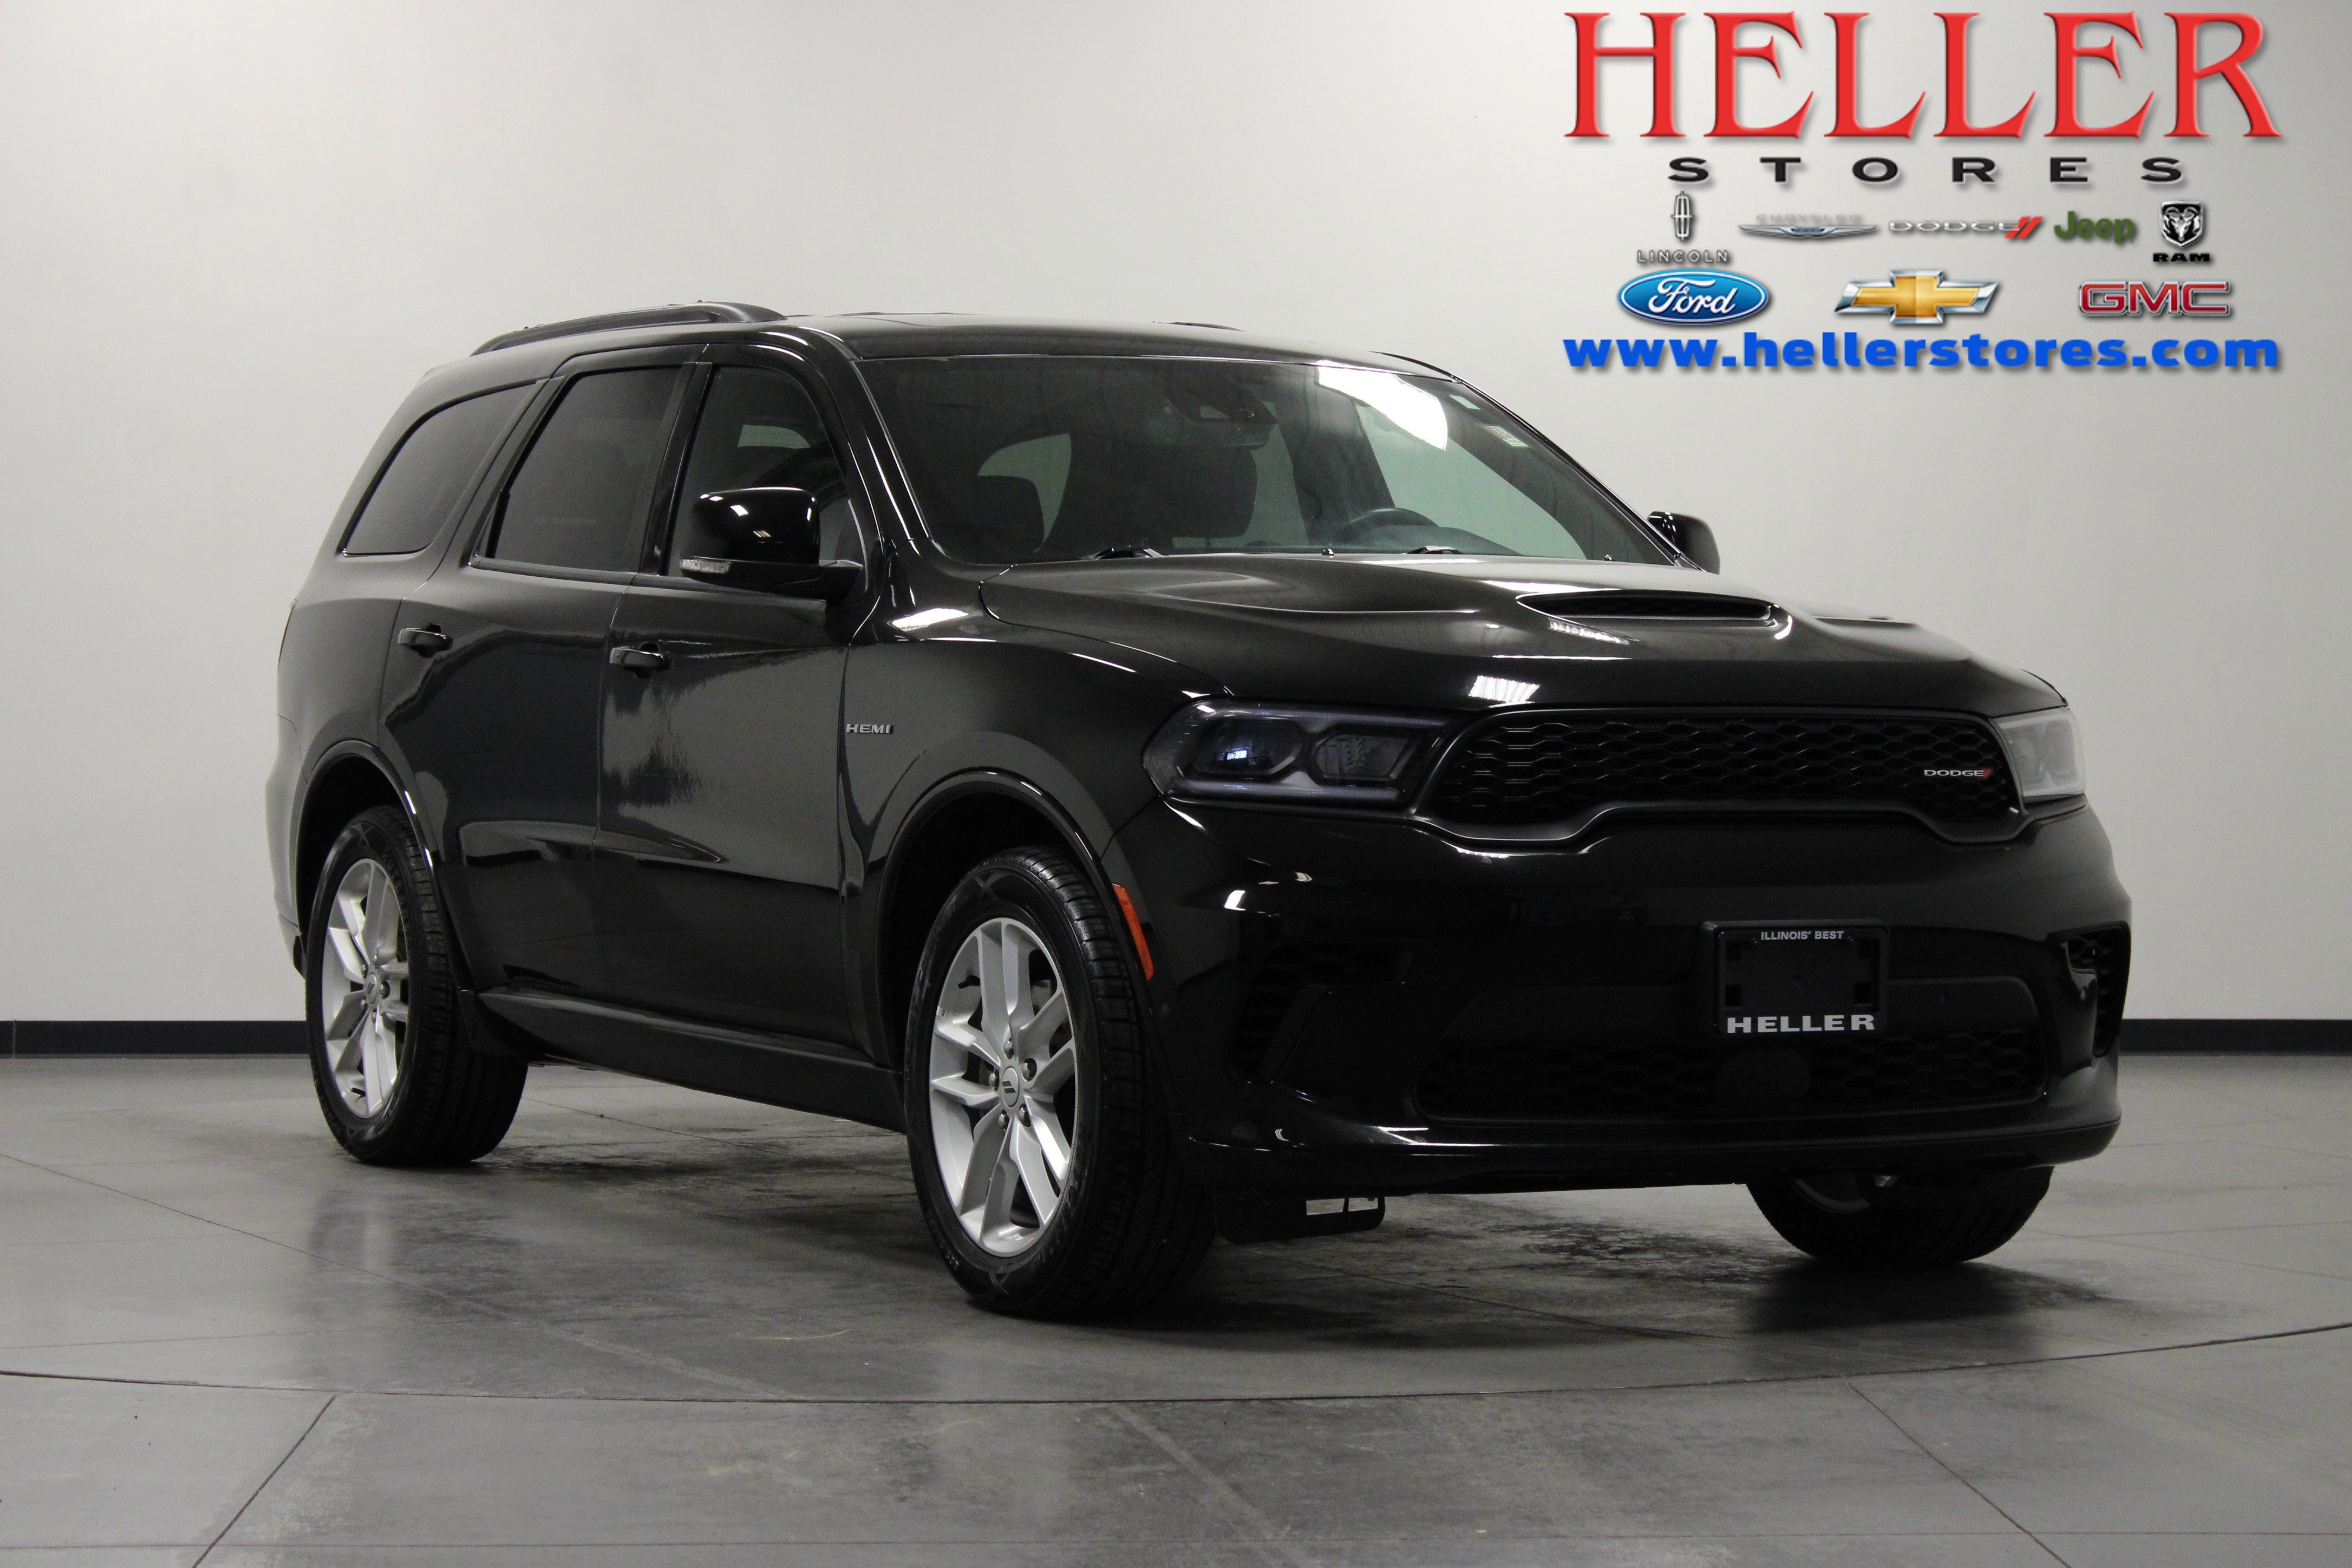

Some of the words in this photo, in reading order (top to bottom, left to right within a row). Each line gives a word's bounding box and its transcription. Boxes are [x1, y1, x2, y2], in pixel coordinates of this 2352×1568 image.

[846, 723, 893, 734] HEMI
[1760, 931, 1811, 940] ILLINOIS'
[1814, 930, 1844, 940] BEST
[1727, 1014, 1874, 1034] HELLER
